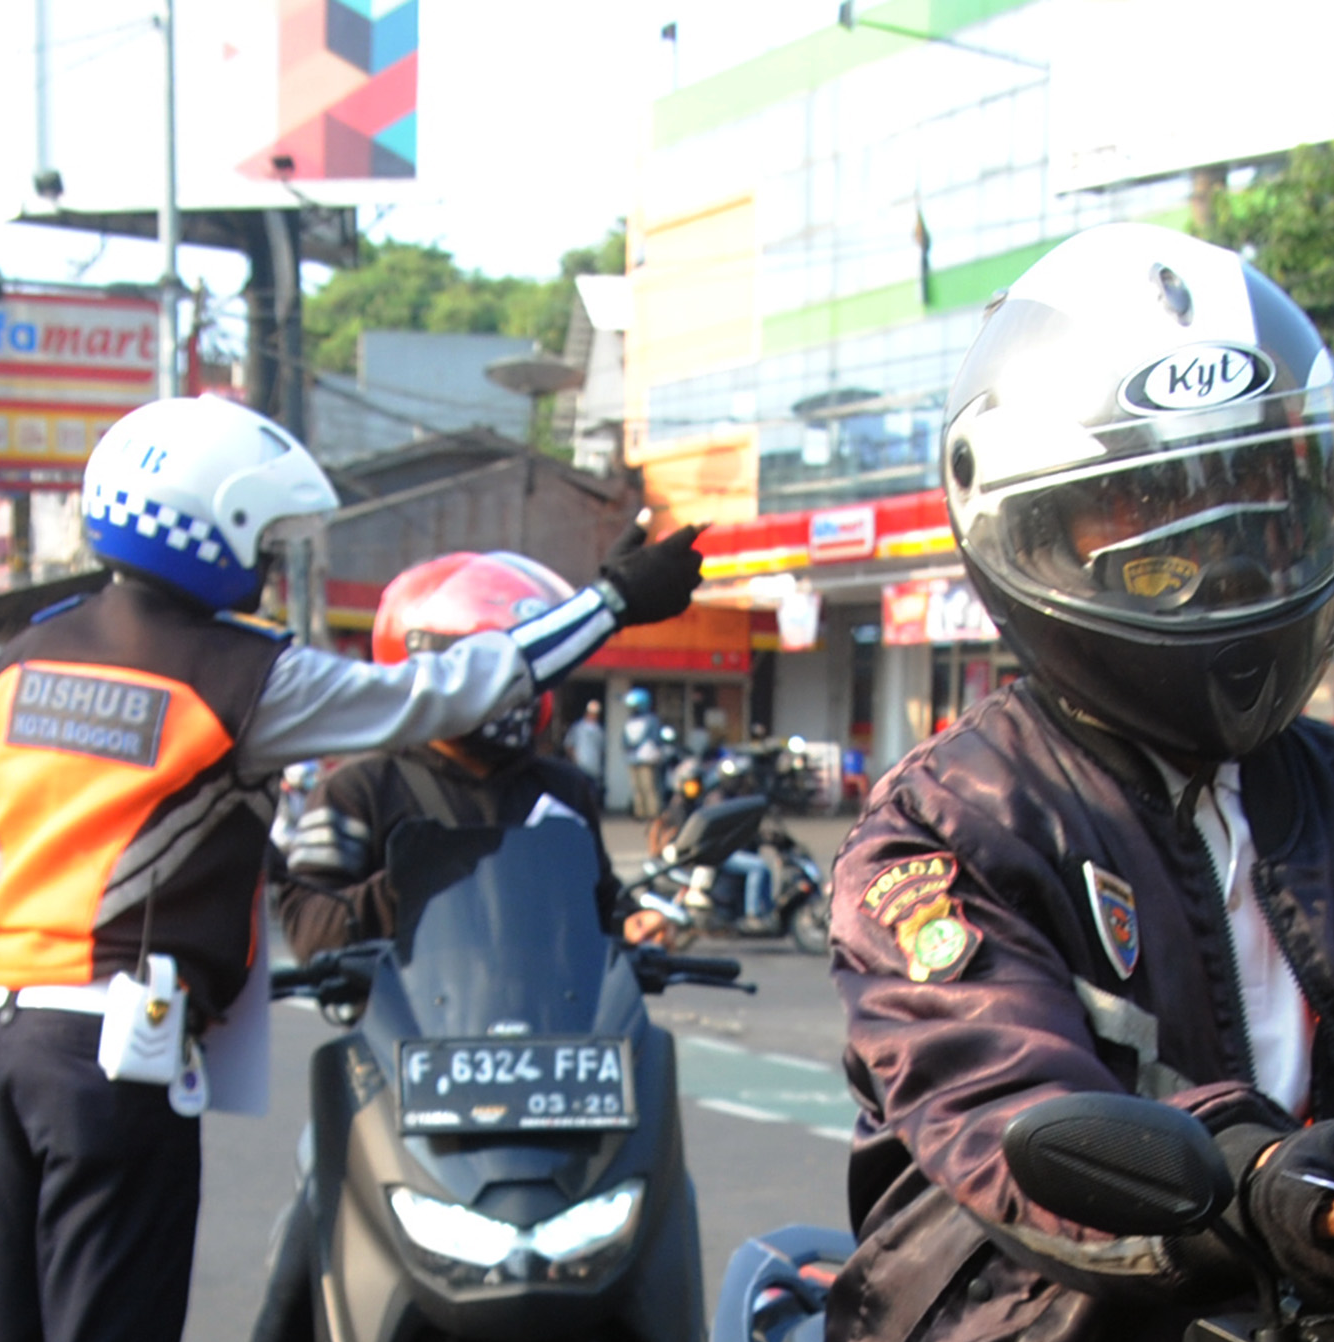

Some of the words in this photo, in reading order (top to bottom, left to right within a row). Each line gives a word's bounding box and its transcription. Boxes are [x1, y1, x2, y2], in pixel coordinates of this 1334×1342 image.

[20, 672, 151, 725] DISHUB
[14, 713, 59, 739] KOTA
[63, 720, 141, 755] BOGOR
[865, 857, 946, 907] POLDA
[408, 1050, 432, 1083] F
[451, 1049, 543, 1084] 6324
[554, 1047, 621, 1083] FFA
